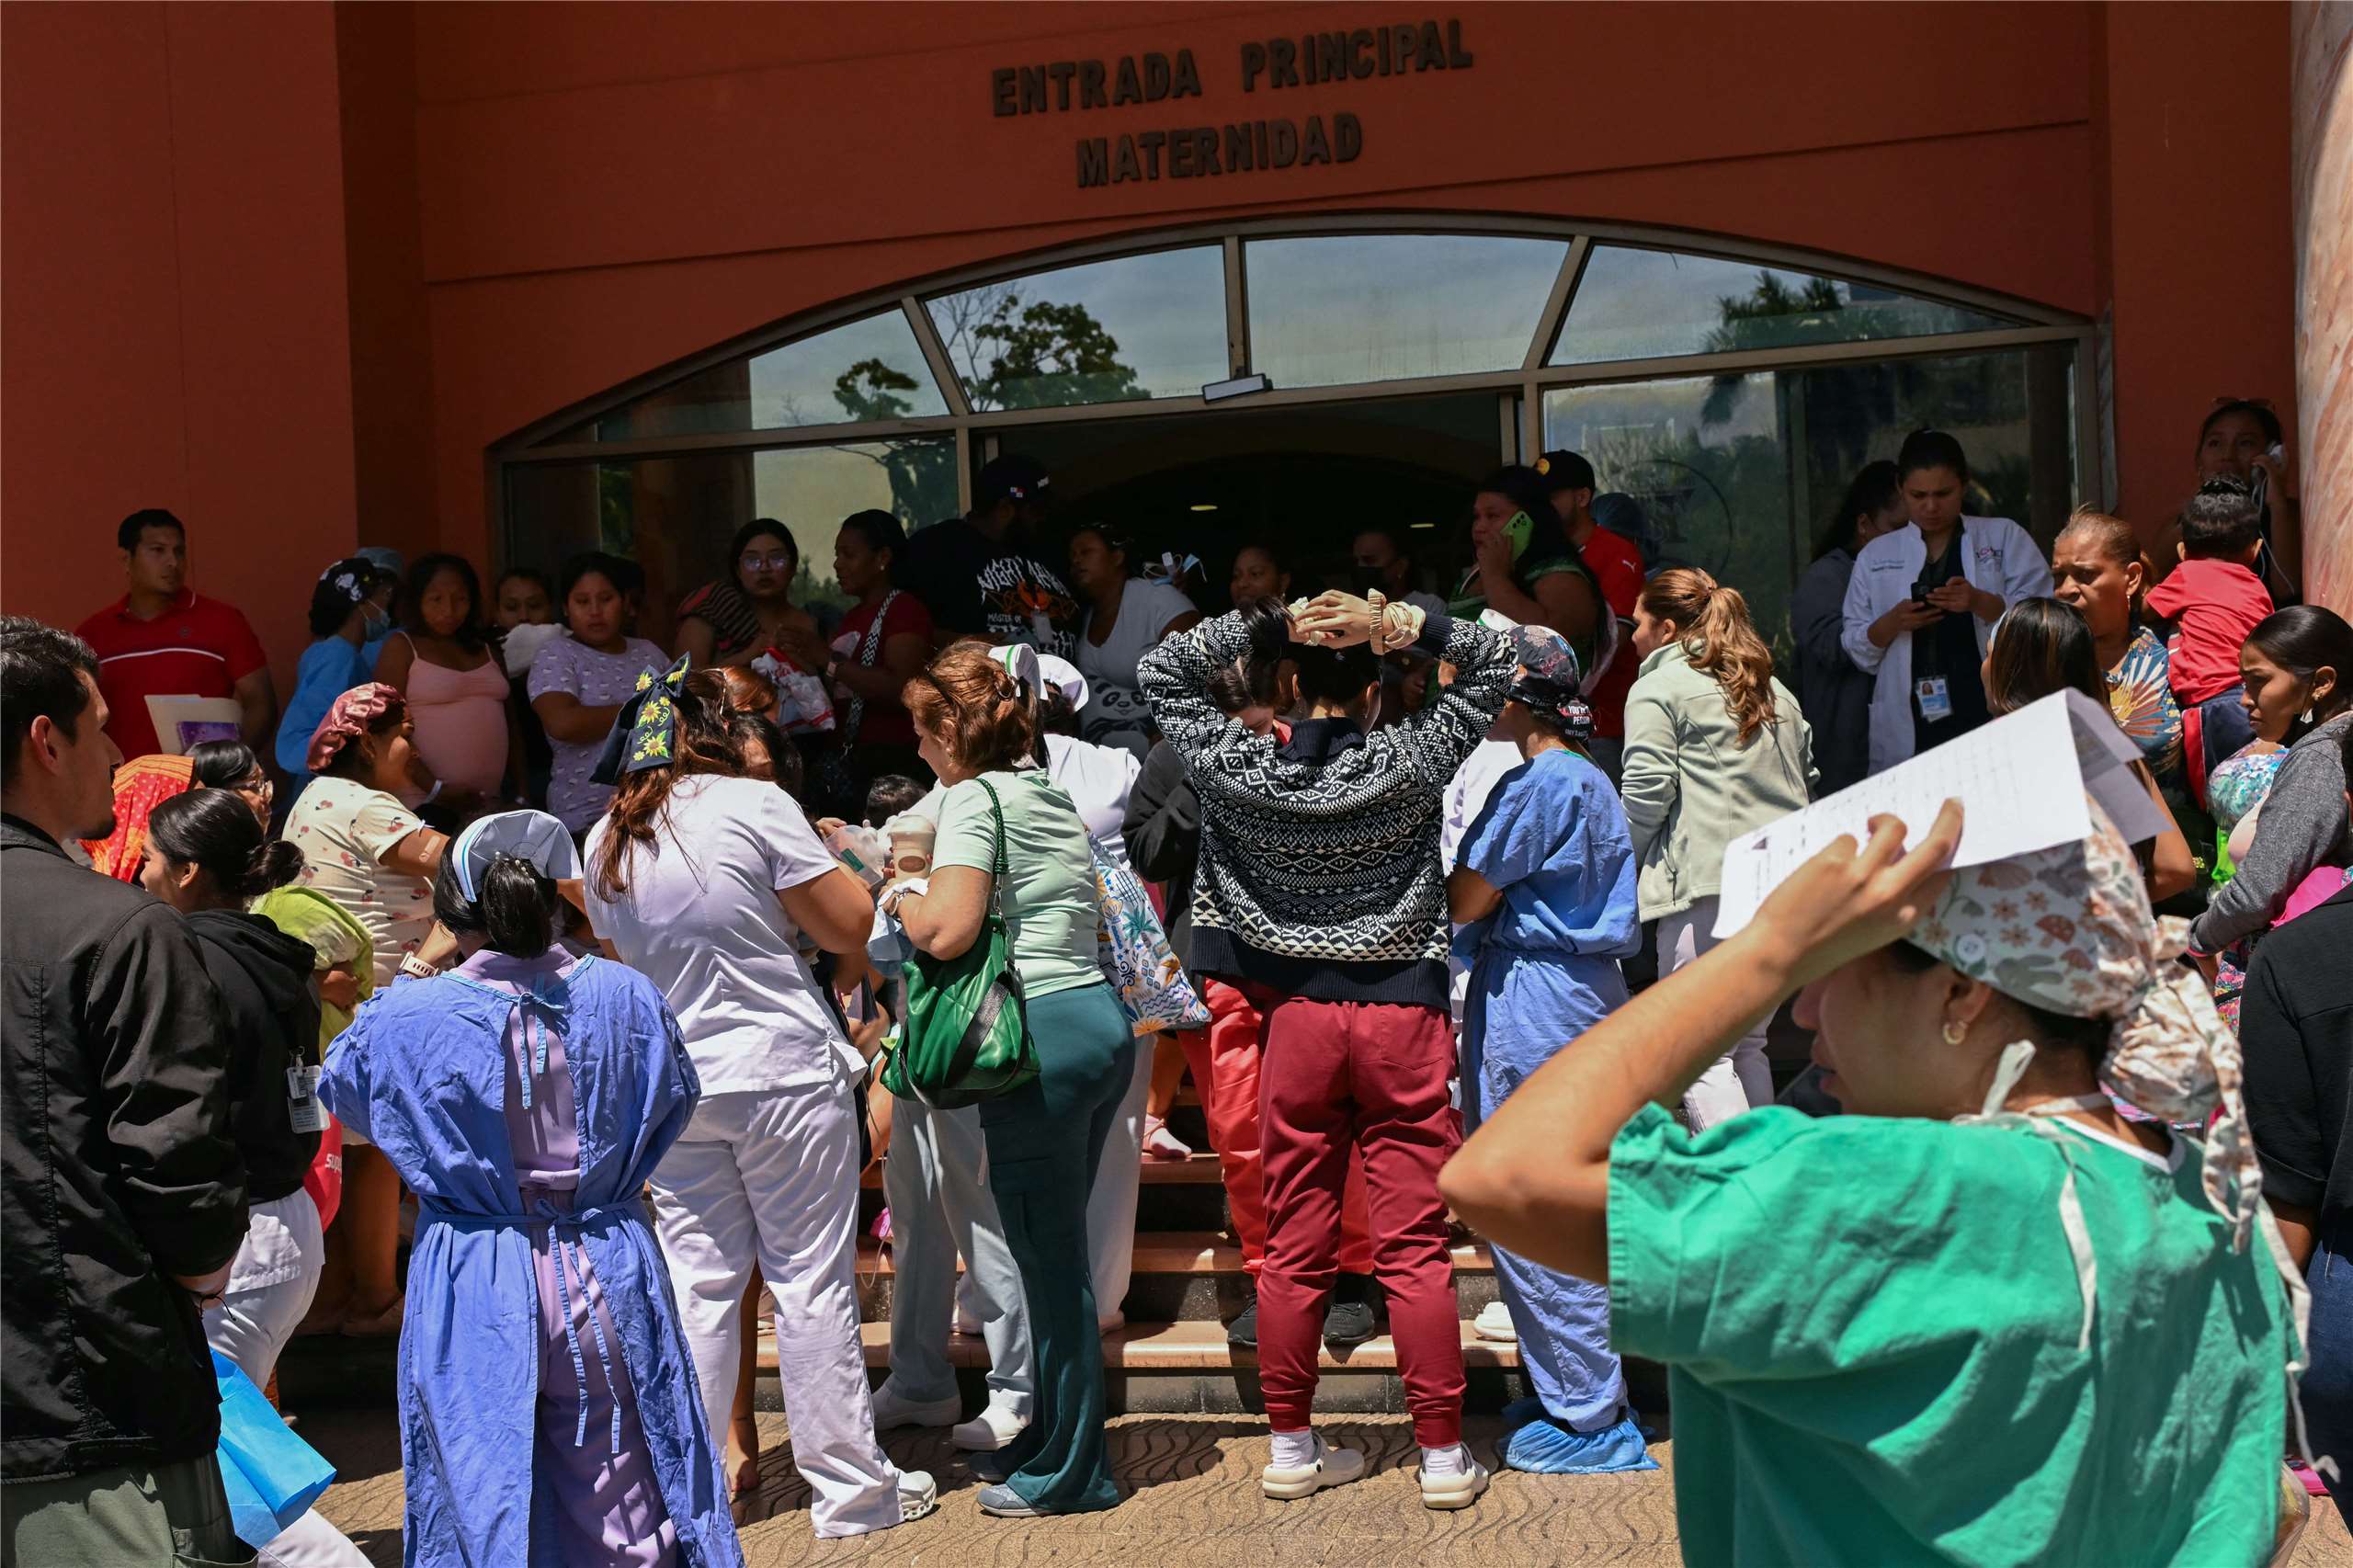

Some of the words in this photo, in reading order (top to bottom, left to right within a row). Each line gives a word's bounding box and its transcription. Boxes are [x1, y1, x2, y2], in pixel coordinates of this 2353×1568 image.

[993, 49, 1202, 117] ENTRADA
[1241, 18, 1472, 92] PRINCIPAL
[1076, 113, 1363, 188] MATERNIDAD
